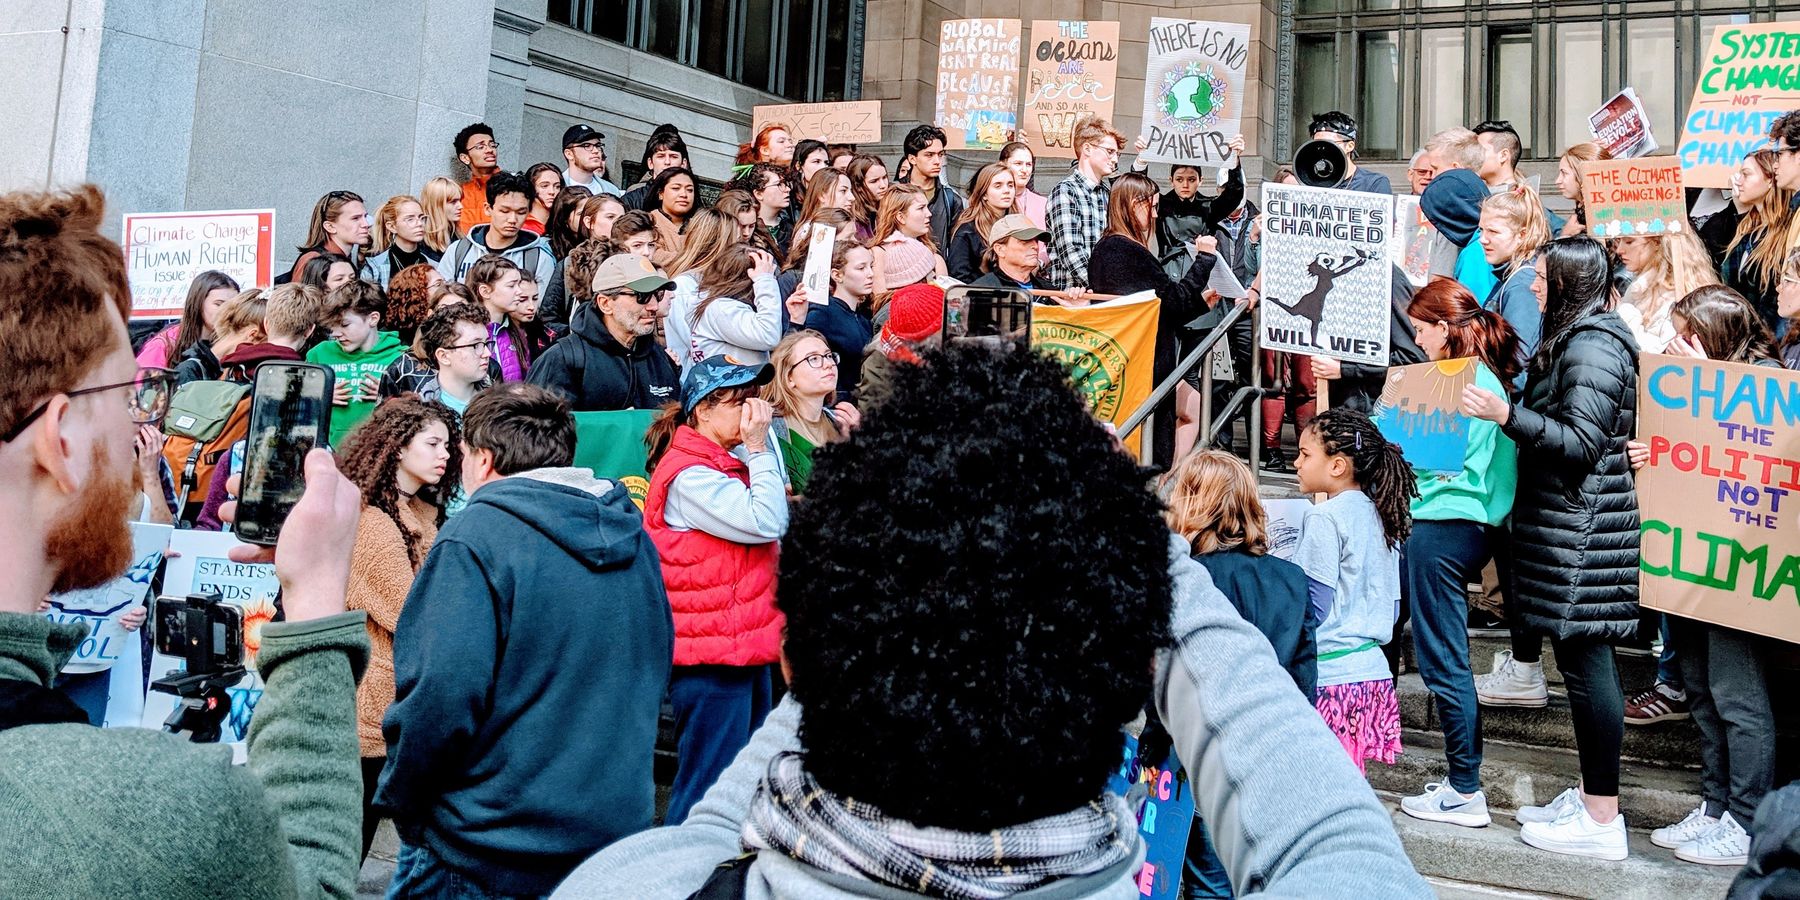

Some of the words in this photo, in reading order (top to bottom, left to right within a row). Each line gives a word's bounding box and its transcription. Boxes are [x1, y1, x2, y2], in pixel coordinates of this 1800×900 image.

[1058, 21, 1089, 39] THE
[1150, 22, 1199, 55] THERE
[1200, 27, 1224, 57] IS
[1218, 37, 1248, 70] NO
[1058, 61, 1085, 74] ARE
[1035, 102, 1053, 110] AND
[1056, 102, 1068, 111] SO
[1072, 102, 1089, 110] ARE
[1732, 95, 1762, 105] NOT
[790, 116, 808, 138] X
[821, 113, 850, 136] Gen
[853, 112, 873, 131] Z
[1598, 106, 1638, 138] EDUCATION
[1687, 109, 1787, 136] CLIMAT
[827, 133, 872, 142] uffering
[1208, 131, 1233, 161] B
[1586, 170, 1622, 186] THE
[1627, 167, 1682, 184] CLIMATE
[1266, 190, 1289, 200] THE
[1591, 192, 1606, 203] IS
[1611, 186, 1680, 202] CHANGING!
[1267, 201, 1384, 226] CLIMATE'S
[134, 226, 195, 244] Climate
[203, 222, 255, 241] Change
[1267, 217, 1384, 244] CHANGED
[134, 248, 191, 269] HUMAN
[200, 242, 257, 265] RIGHTS
[155, 270, 186, 282] issue
[1330, 336, 1382, 356] WE?
[1648, 364, 1800, 426] CHAN
[1718, 422, 1774, 447] THE
[1718, 479, 1789, 513] NOT
[1729, 507, 1778, 530] THE
[199, 562, 268, 578] STARTS
[1639, 518, 1800, 606] CLIMA
[77, 636, 119, 660] OL.
